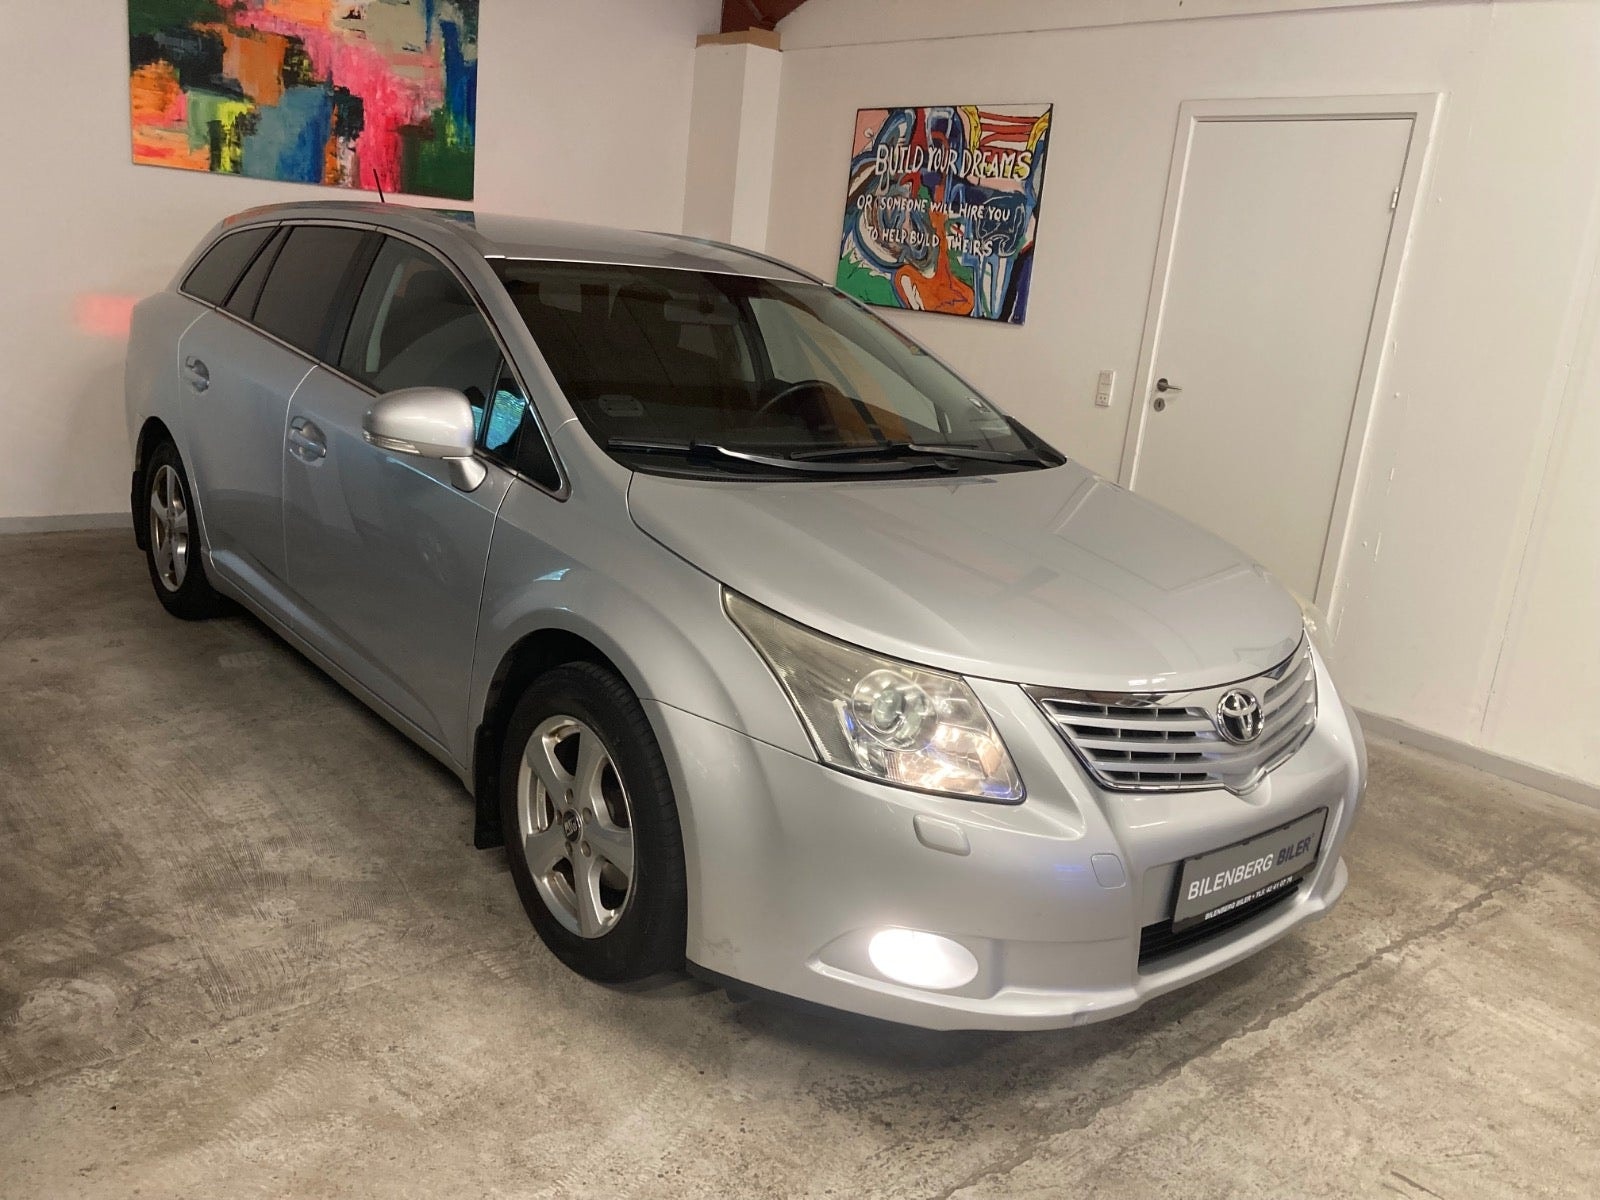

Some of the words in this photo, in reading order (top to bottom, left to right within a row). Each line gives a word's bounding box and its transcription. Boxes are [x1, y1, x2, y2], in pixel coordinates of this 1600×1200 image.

[875, 144, 924, 176] BUILD
[927, 146, 958, 175] YOUR
[960, 149, 1032, 181] DREAMS
[857, 195, 873, 210] OR
[880, 197, 928, 213] SOMEONE
[930, 201, 955, 215] WILL
[960, 203, 985, 221] HIRE
[988, 205, 1011, 222] YOU
[866, 225, 879, 240] TO
[883, 229, 907, 244] HELP
[910, 230, 940, 248] BUILD
[945, 231, 993, 257] THEIRS
[1187, 853, 1274, 901] BILENBERG
[1277, 836, 1312, 866] BILER
